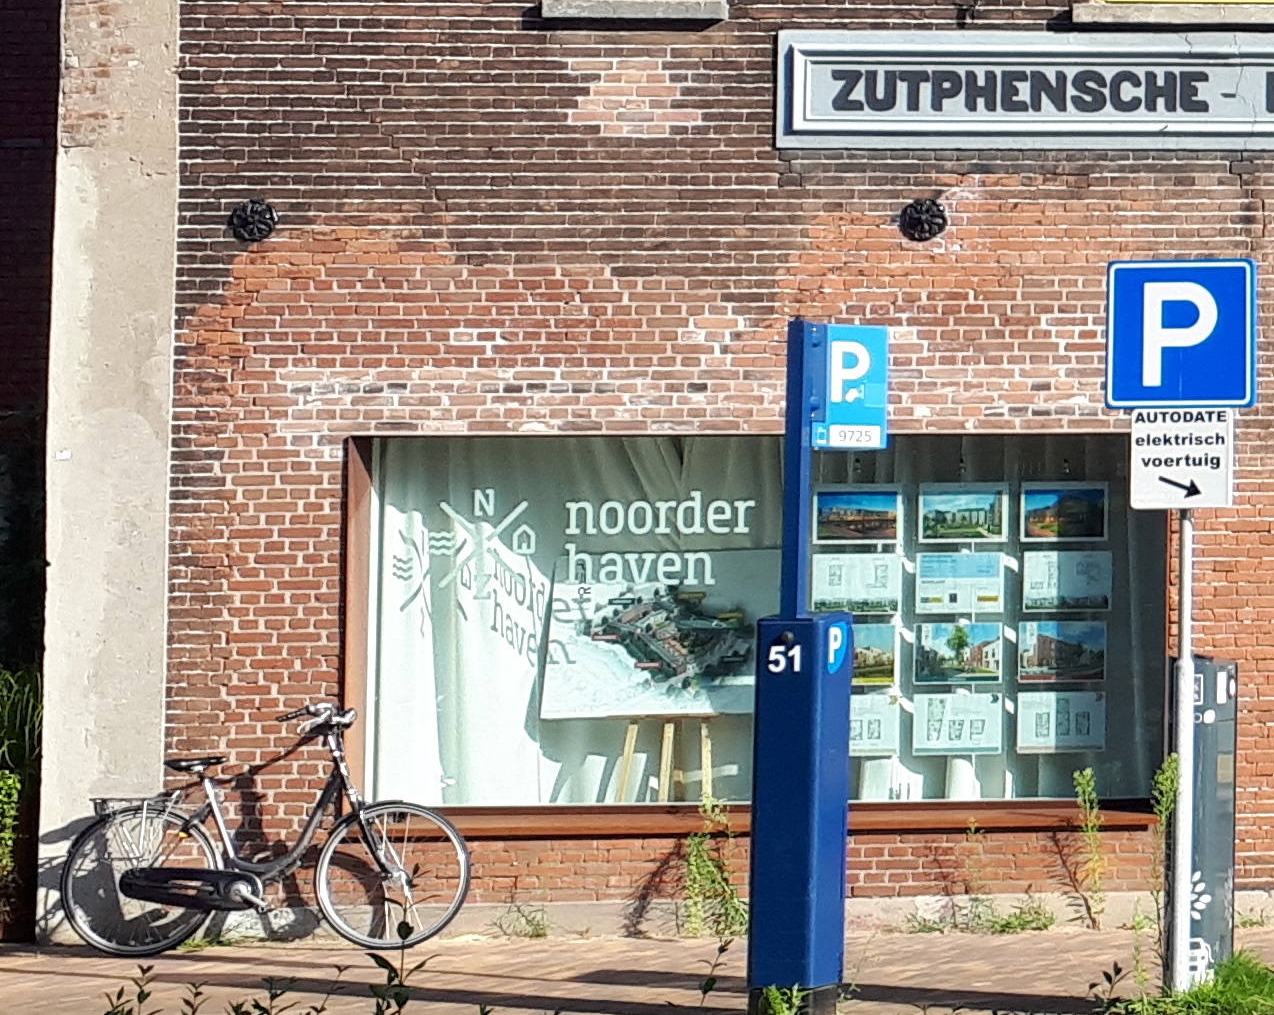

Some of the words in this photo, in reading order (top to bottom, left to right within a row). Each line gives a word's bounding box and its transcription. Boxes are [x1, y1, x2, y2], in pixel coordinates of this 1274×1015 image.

[831, 69, 1210, 113] ZUTPHENSCHE
[1142, 281, 1219, 387] P
[830, 340, 871, 403] P
[838, 430, 872, 443] 9725
[1134, 411, 1228, 424] AUTODATE
[1135, 432, 1226, 447] elektrisch
[1141, 453, 1221, 470] voertuig
[564, 491, 756, 535] noorder
[564, 543, 716, 586] haven
[767, 644, 802, 673] 51
[828, 626, 843, 664] P
